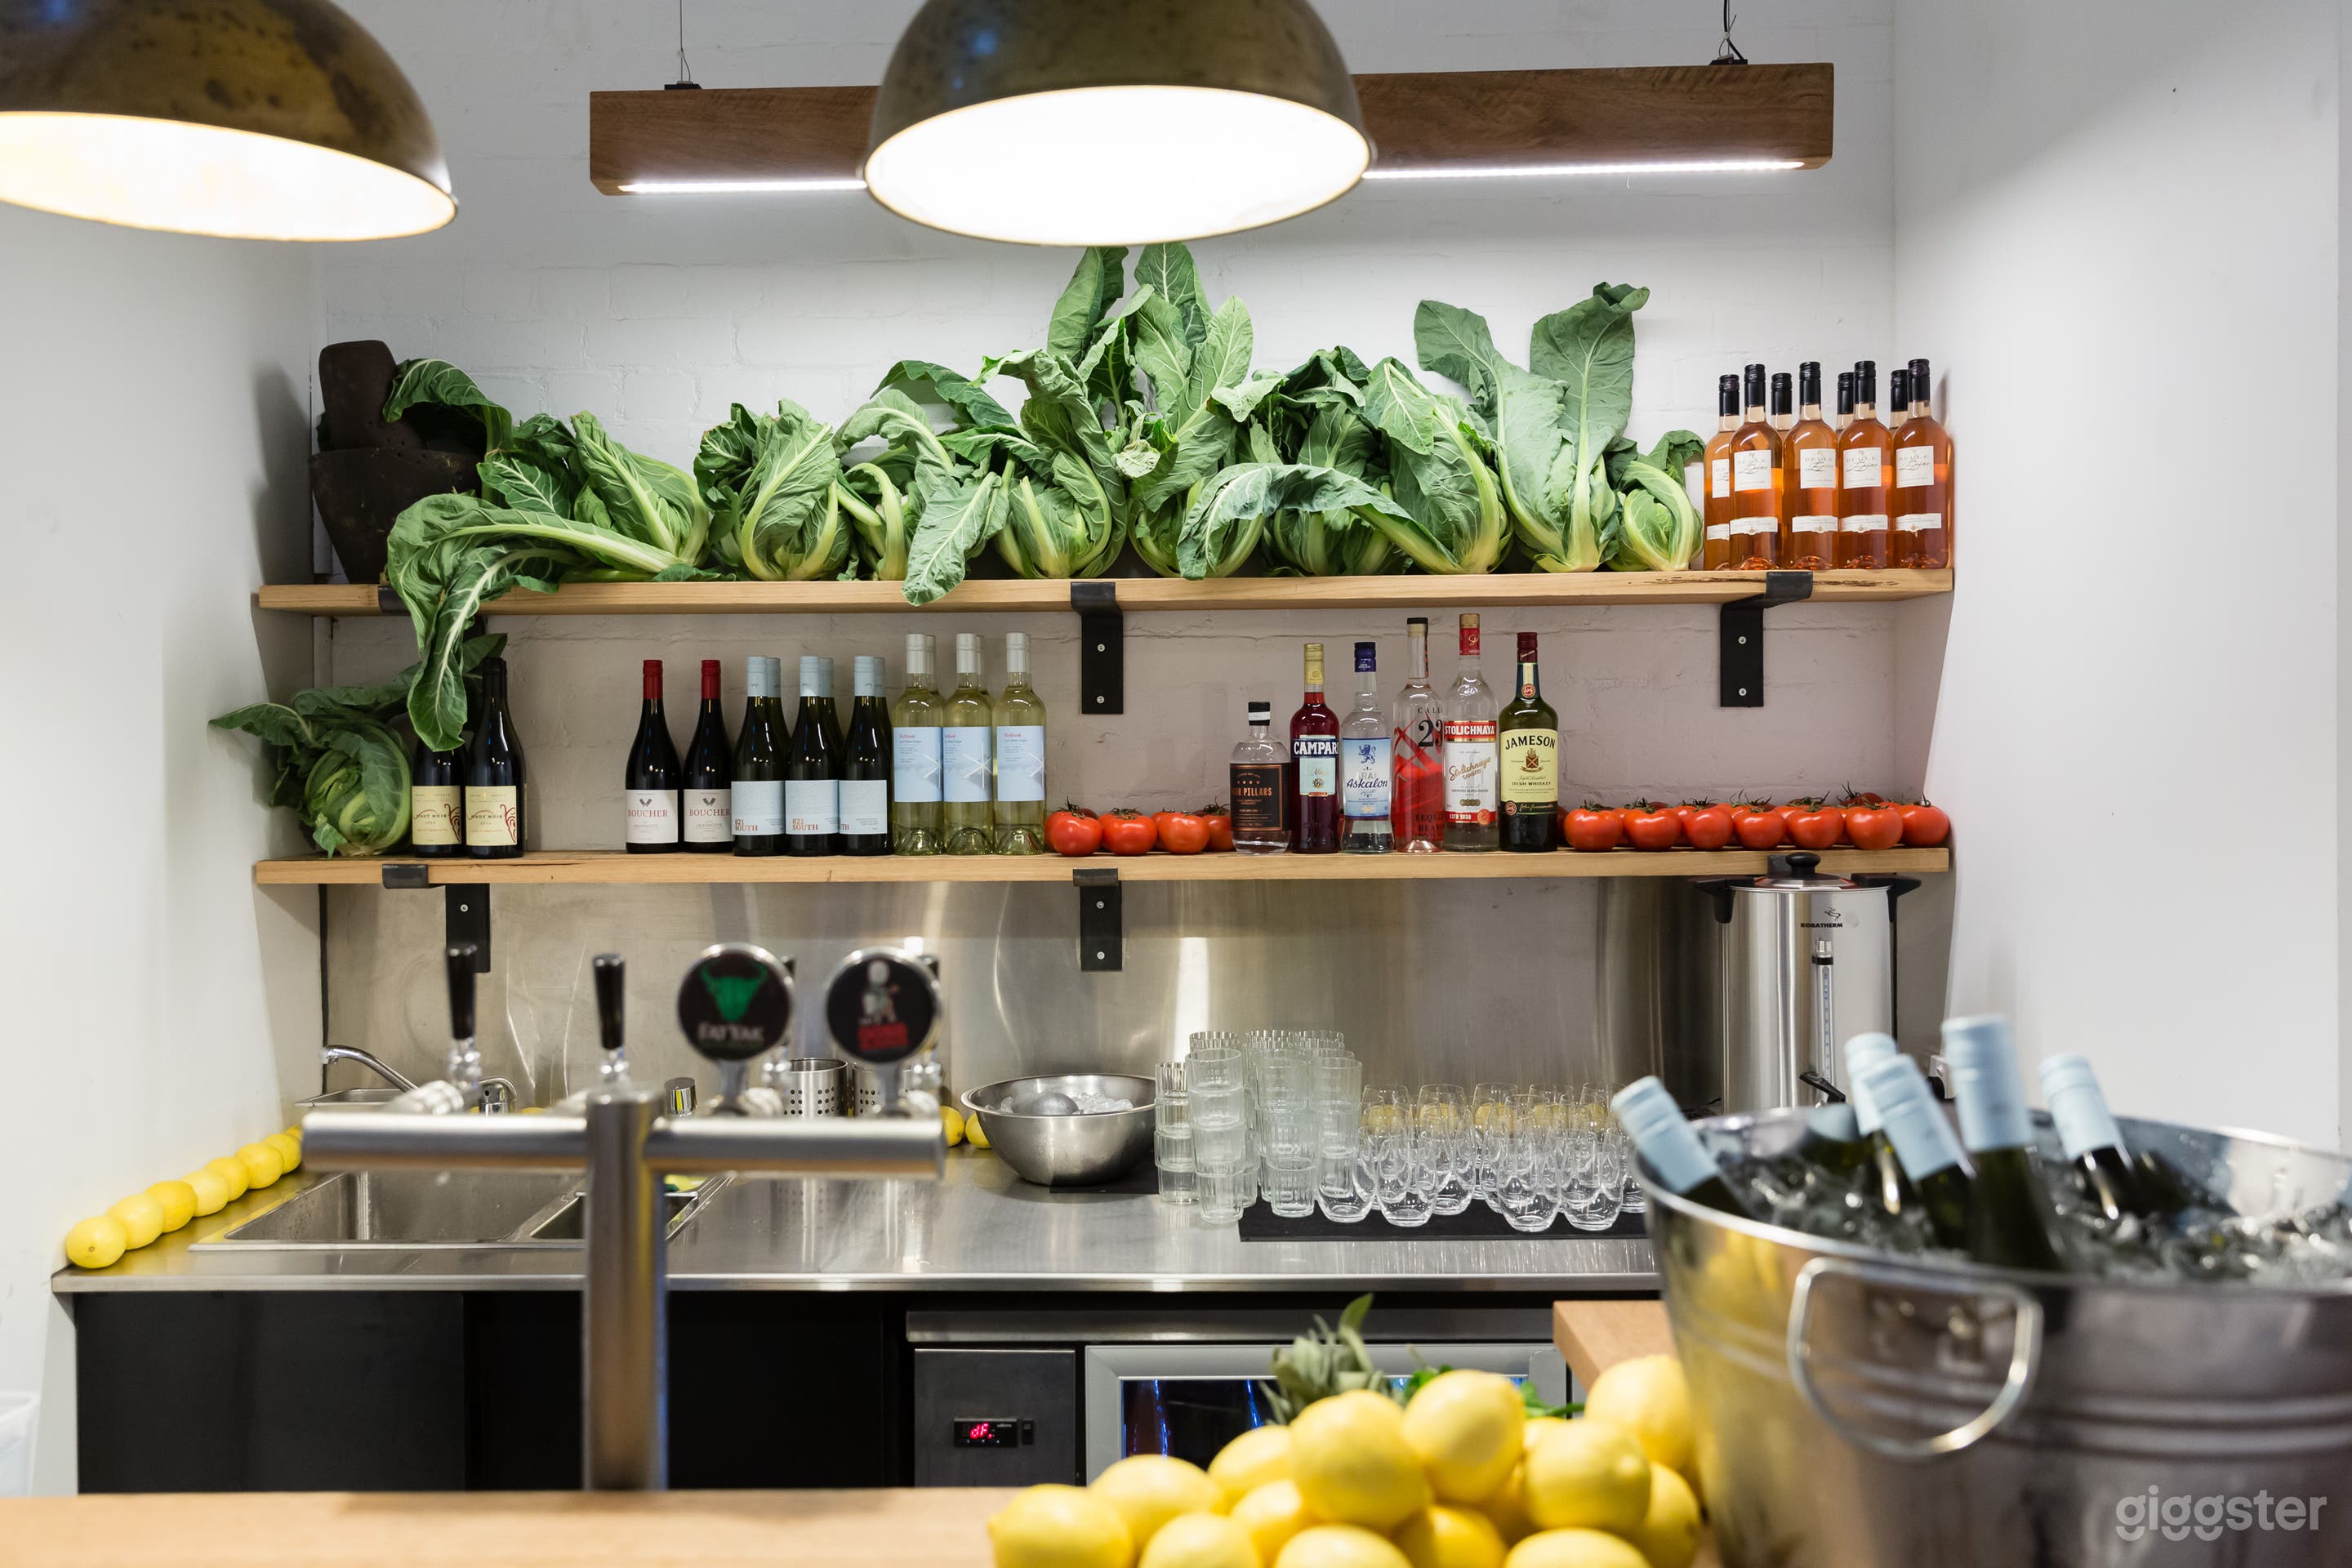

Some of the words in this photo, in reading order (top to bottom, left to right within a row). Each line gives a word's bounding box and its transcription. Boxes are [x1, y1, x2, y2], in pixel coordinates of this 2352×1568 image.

[1445, 725, 1495, 735] STOLICHNAYA
[1505, 735, 1556, 750] JAMESON
[1346, 777, 1388, 788] Askalon
[1243, 787, 1272, 796] PILLARS
[627, 809, 668, 817] BOUCHER
[689, 808, 731, 817] BOUCHER
